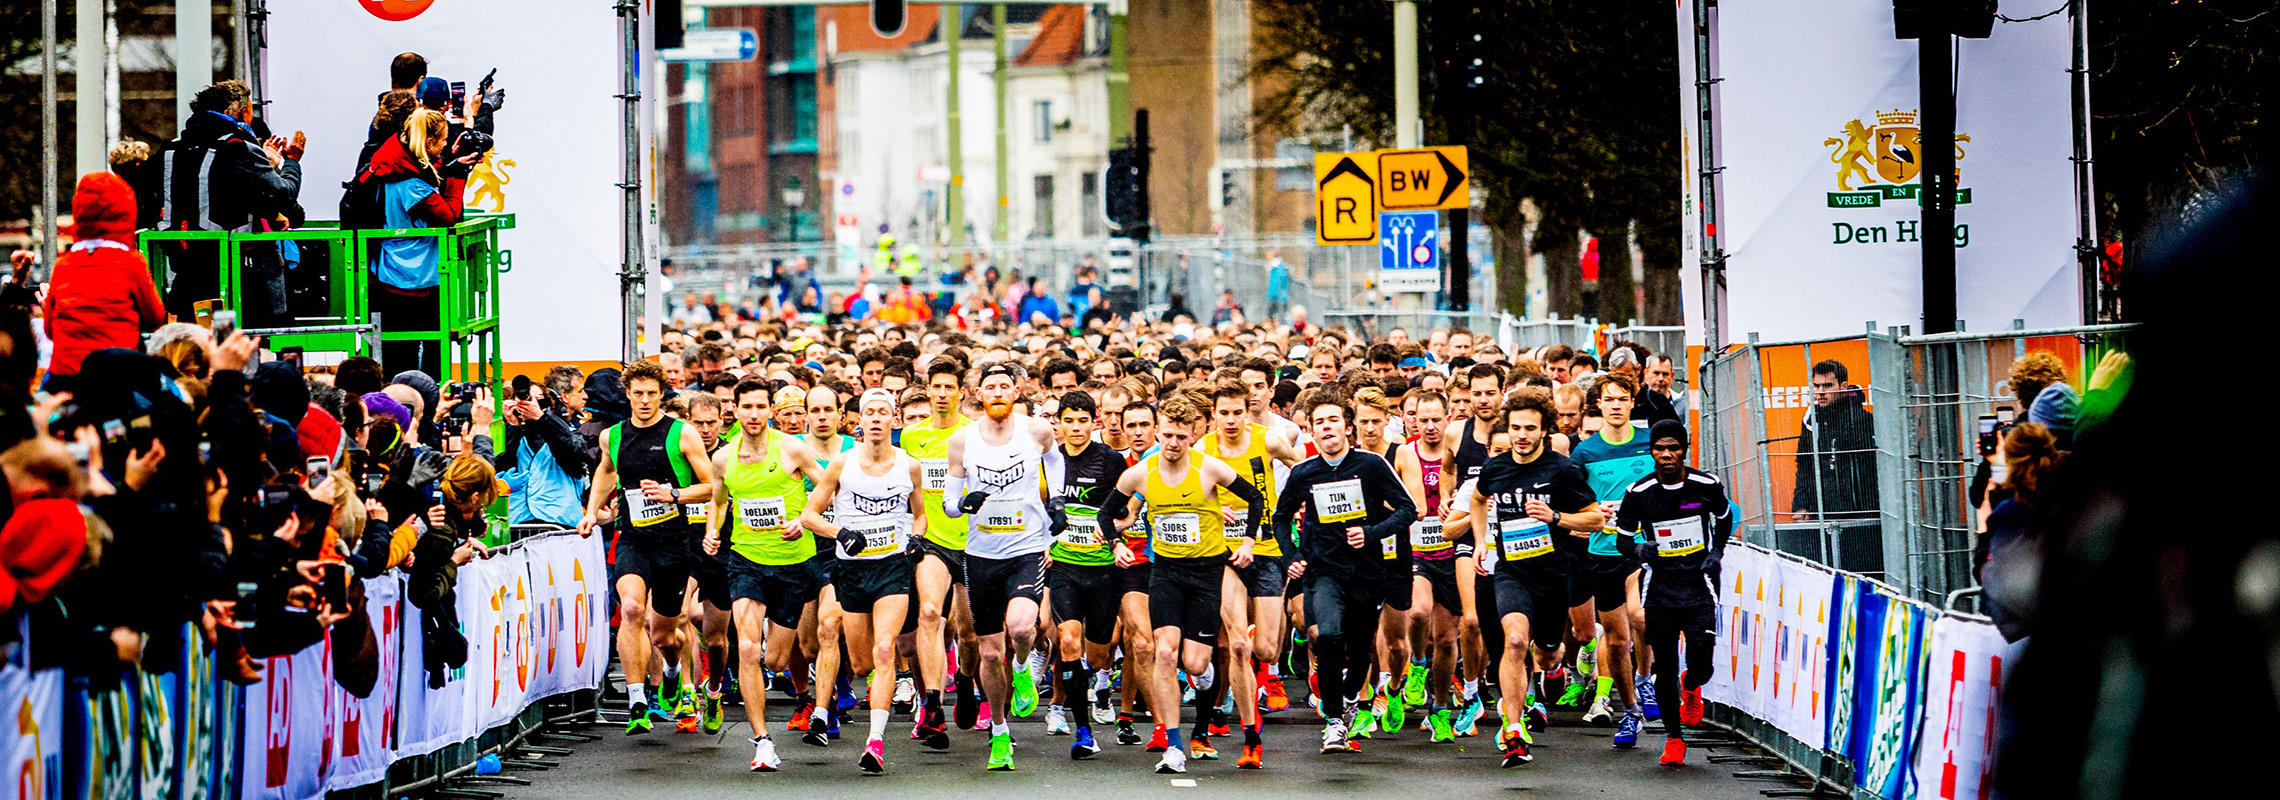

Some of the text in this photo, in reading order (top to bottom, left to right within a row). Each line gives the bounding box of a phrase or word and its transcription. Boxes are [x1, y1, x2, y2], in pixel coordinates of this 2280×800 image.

[1391, 170, 1430, 191] BW
[1836, 188, 1906, 206] VREDE EN
[1335, 197, 1356, 224] R
[1832, 220, 1969, 248] Den Hg
[641, 507, 665, 519] 17735
[686, 506, 699, 516] 014
[1327, 503, 1352, 514] 12021
[750, 518, 775, 528] 12004
[988, 516, 1012, 526] 17891
[1162, 523, 1187, 532] SJORS
[866, 536, 887, 548] 7537
[1514, 539, 1541, 552] 44043
[1669, 539, 1692, 549] 18611
